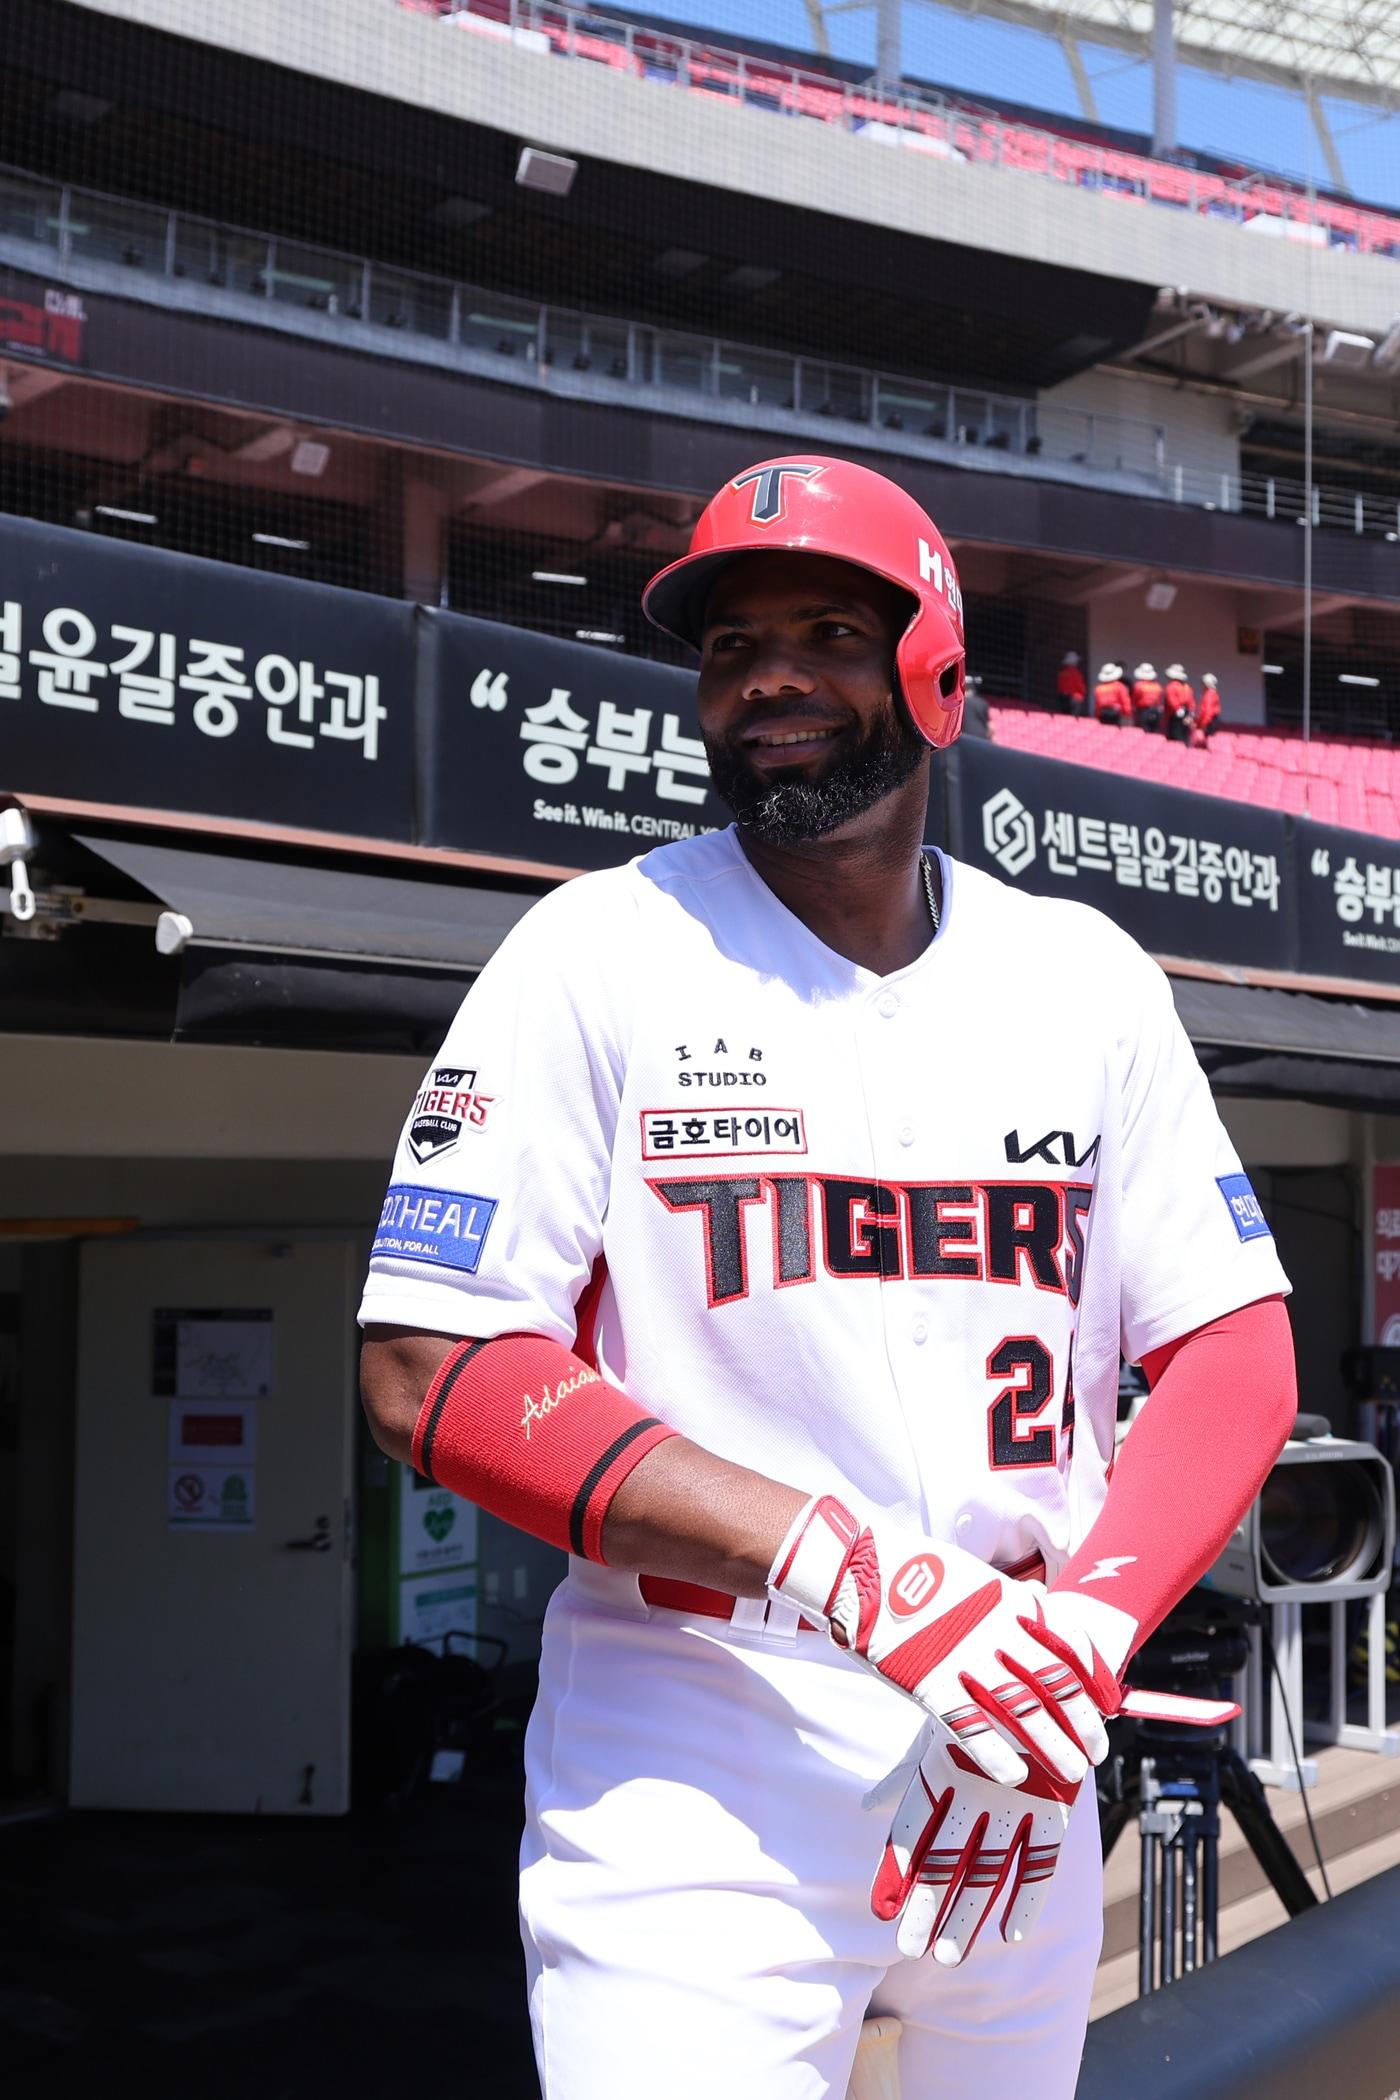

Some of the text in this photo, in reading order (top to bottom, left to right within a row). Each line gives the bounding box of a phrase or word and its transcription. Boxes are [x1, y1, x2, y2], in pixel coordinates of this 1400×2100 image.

[1042, 810, 1280, 911] 센트럴윤길중안과
[678, 1072, 766, 1087] STUDIO
[414, 1119, 458, 1132] BASEBALL CLUB
[649, 1116, 800, 1149] 금호타이어
[987, 1335, 1075, 1471] 2
